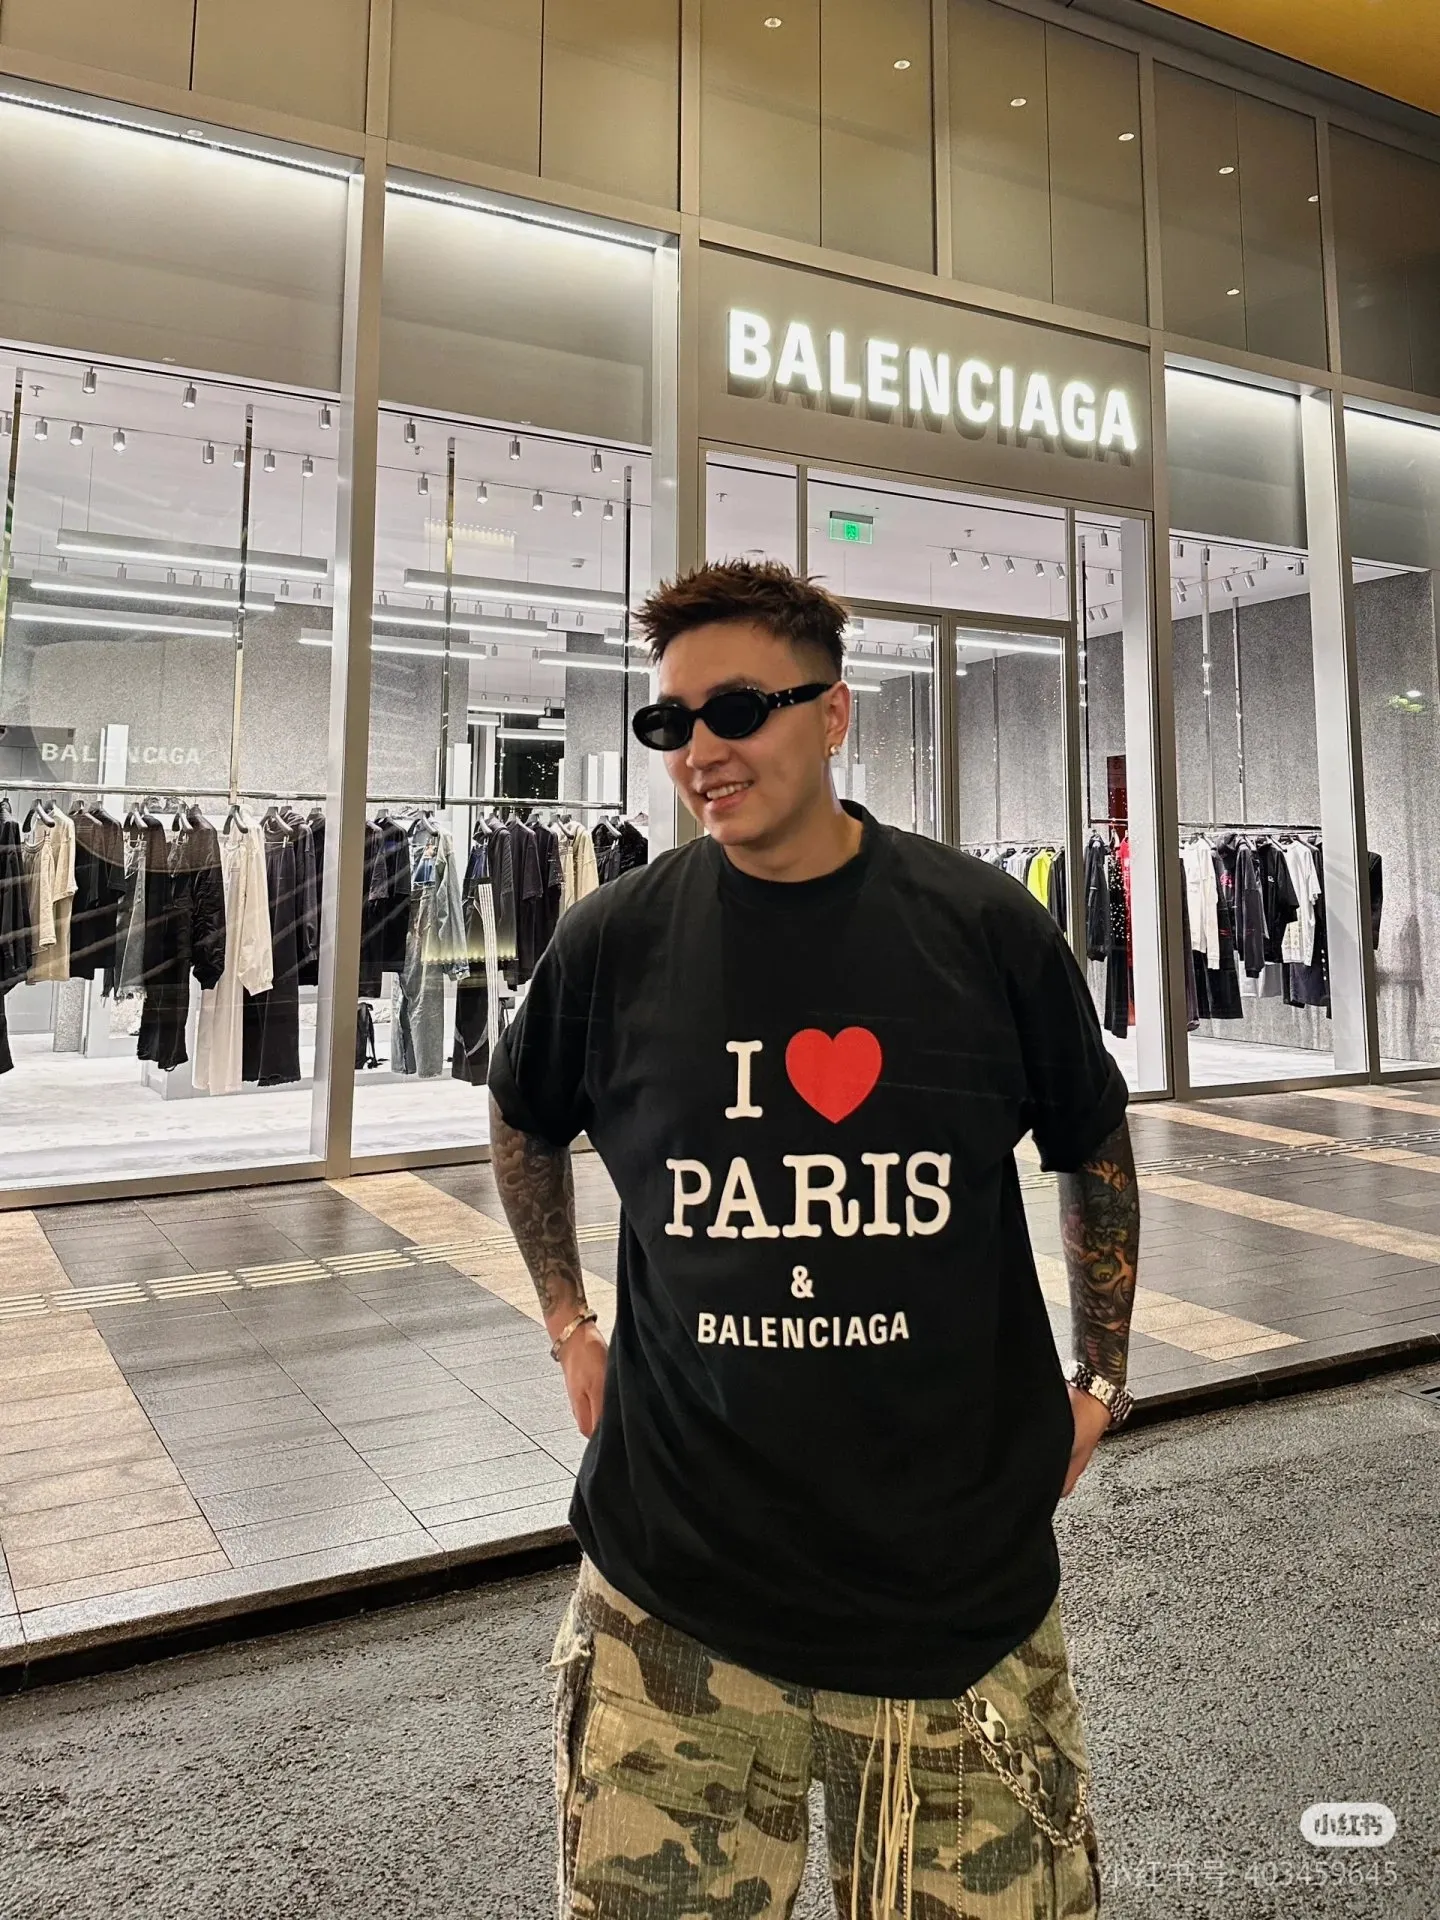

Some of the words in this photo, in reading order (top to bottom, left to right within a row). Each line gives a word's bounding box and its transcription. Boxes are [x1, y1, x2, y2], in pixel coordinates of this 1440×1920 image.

[728, 308, 1138, 451] BALENCIAGA
[726, 1040, 763, 1119] I
[665, 1151, 951, 1239] PARIS
[791, 1265, 814, 1298] &
[697, 1311, 909, 1348] BALENCIAGA
